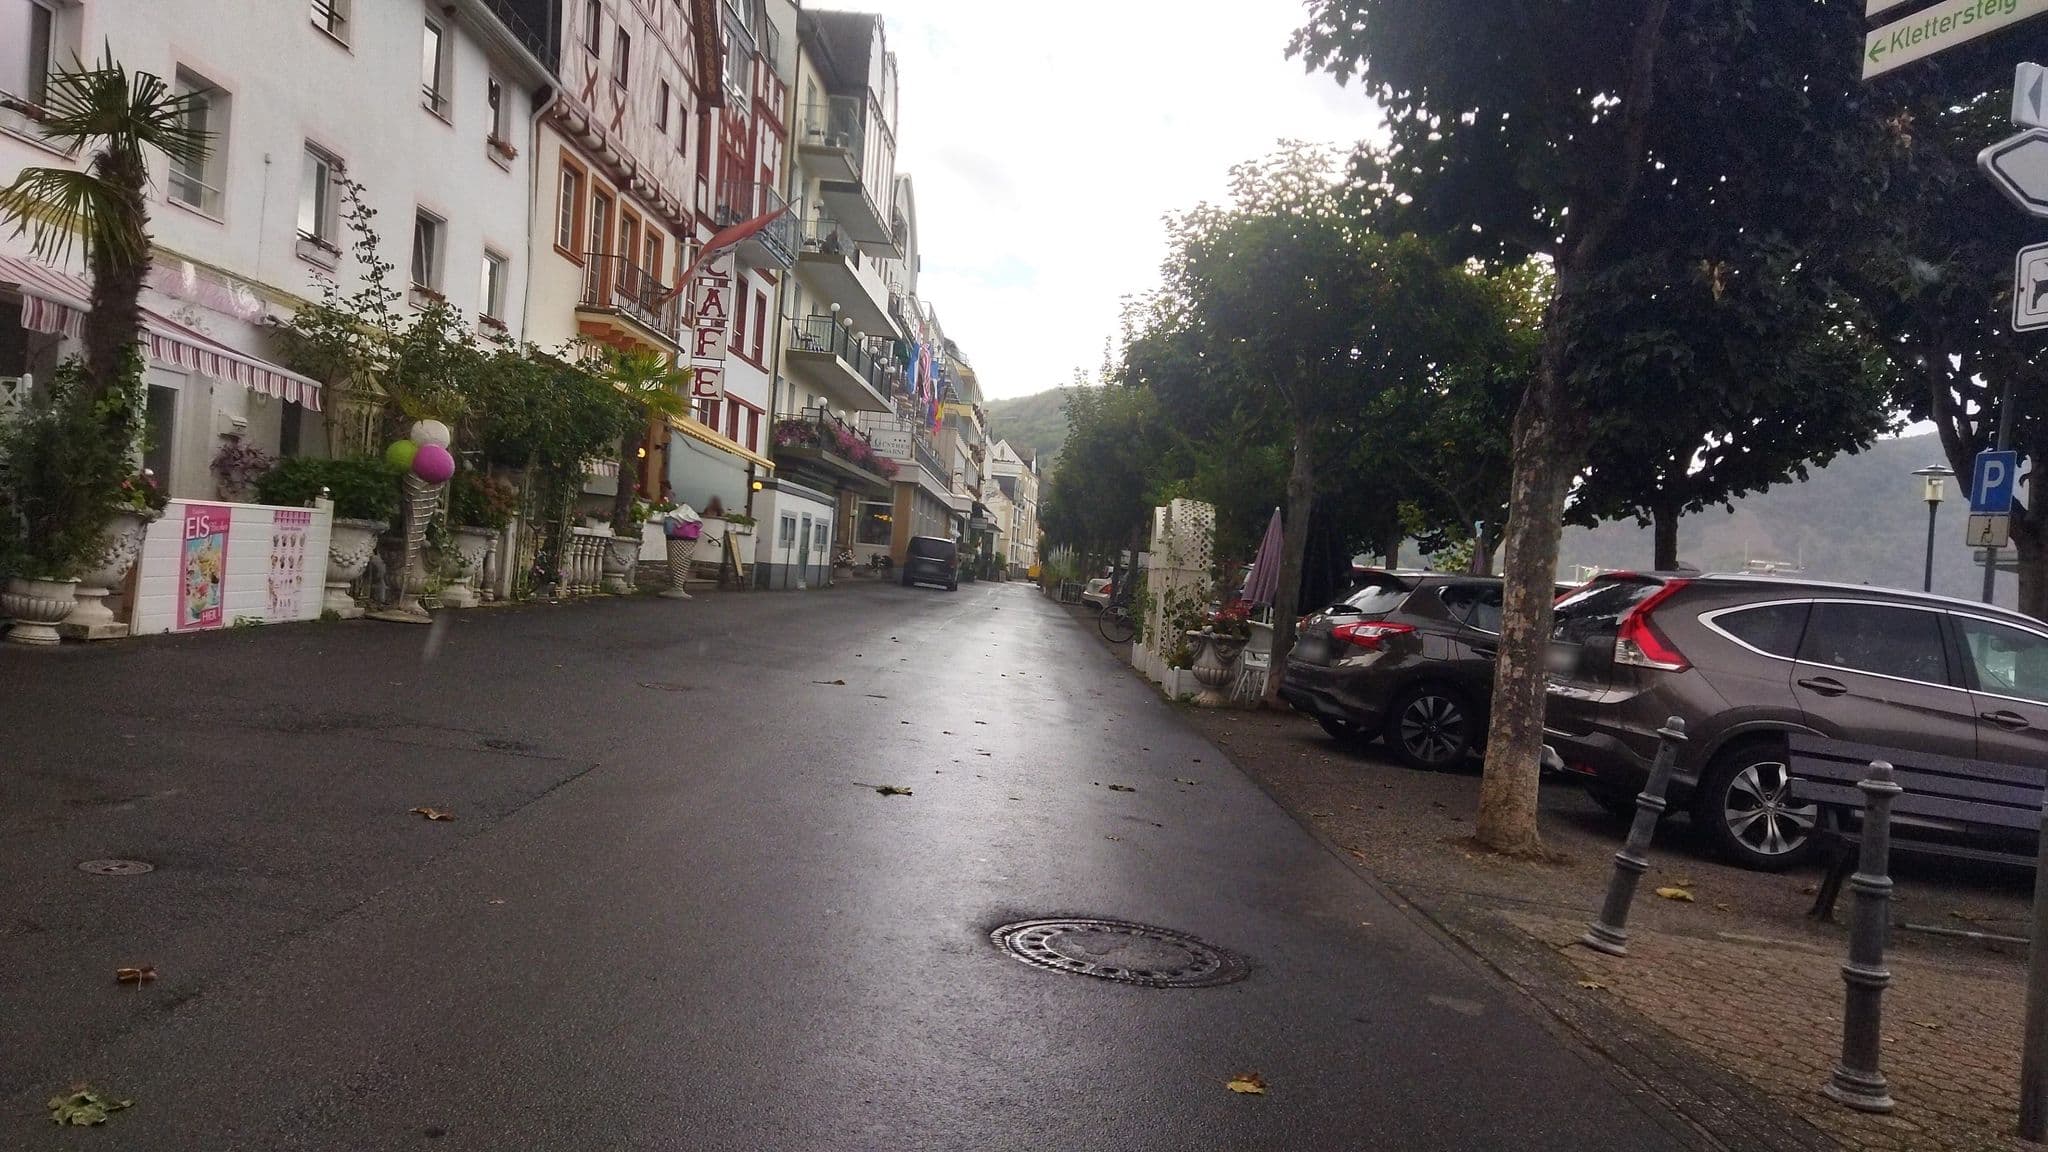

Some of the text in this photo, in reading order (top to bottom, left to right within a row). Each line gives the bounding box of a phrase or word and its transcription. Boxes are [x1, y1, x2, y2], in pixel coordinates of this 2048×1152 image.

[1890, 0, 2017, 53] Klettersteig
[1980, 460, 2006, 505] P
[185, 514, 210, 540] EIS
